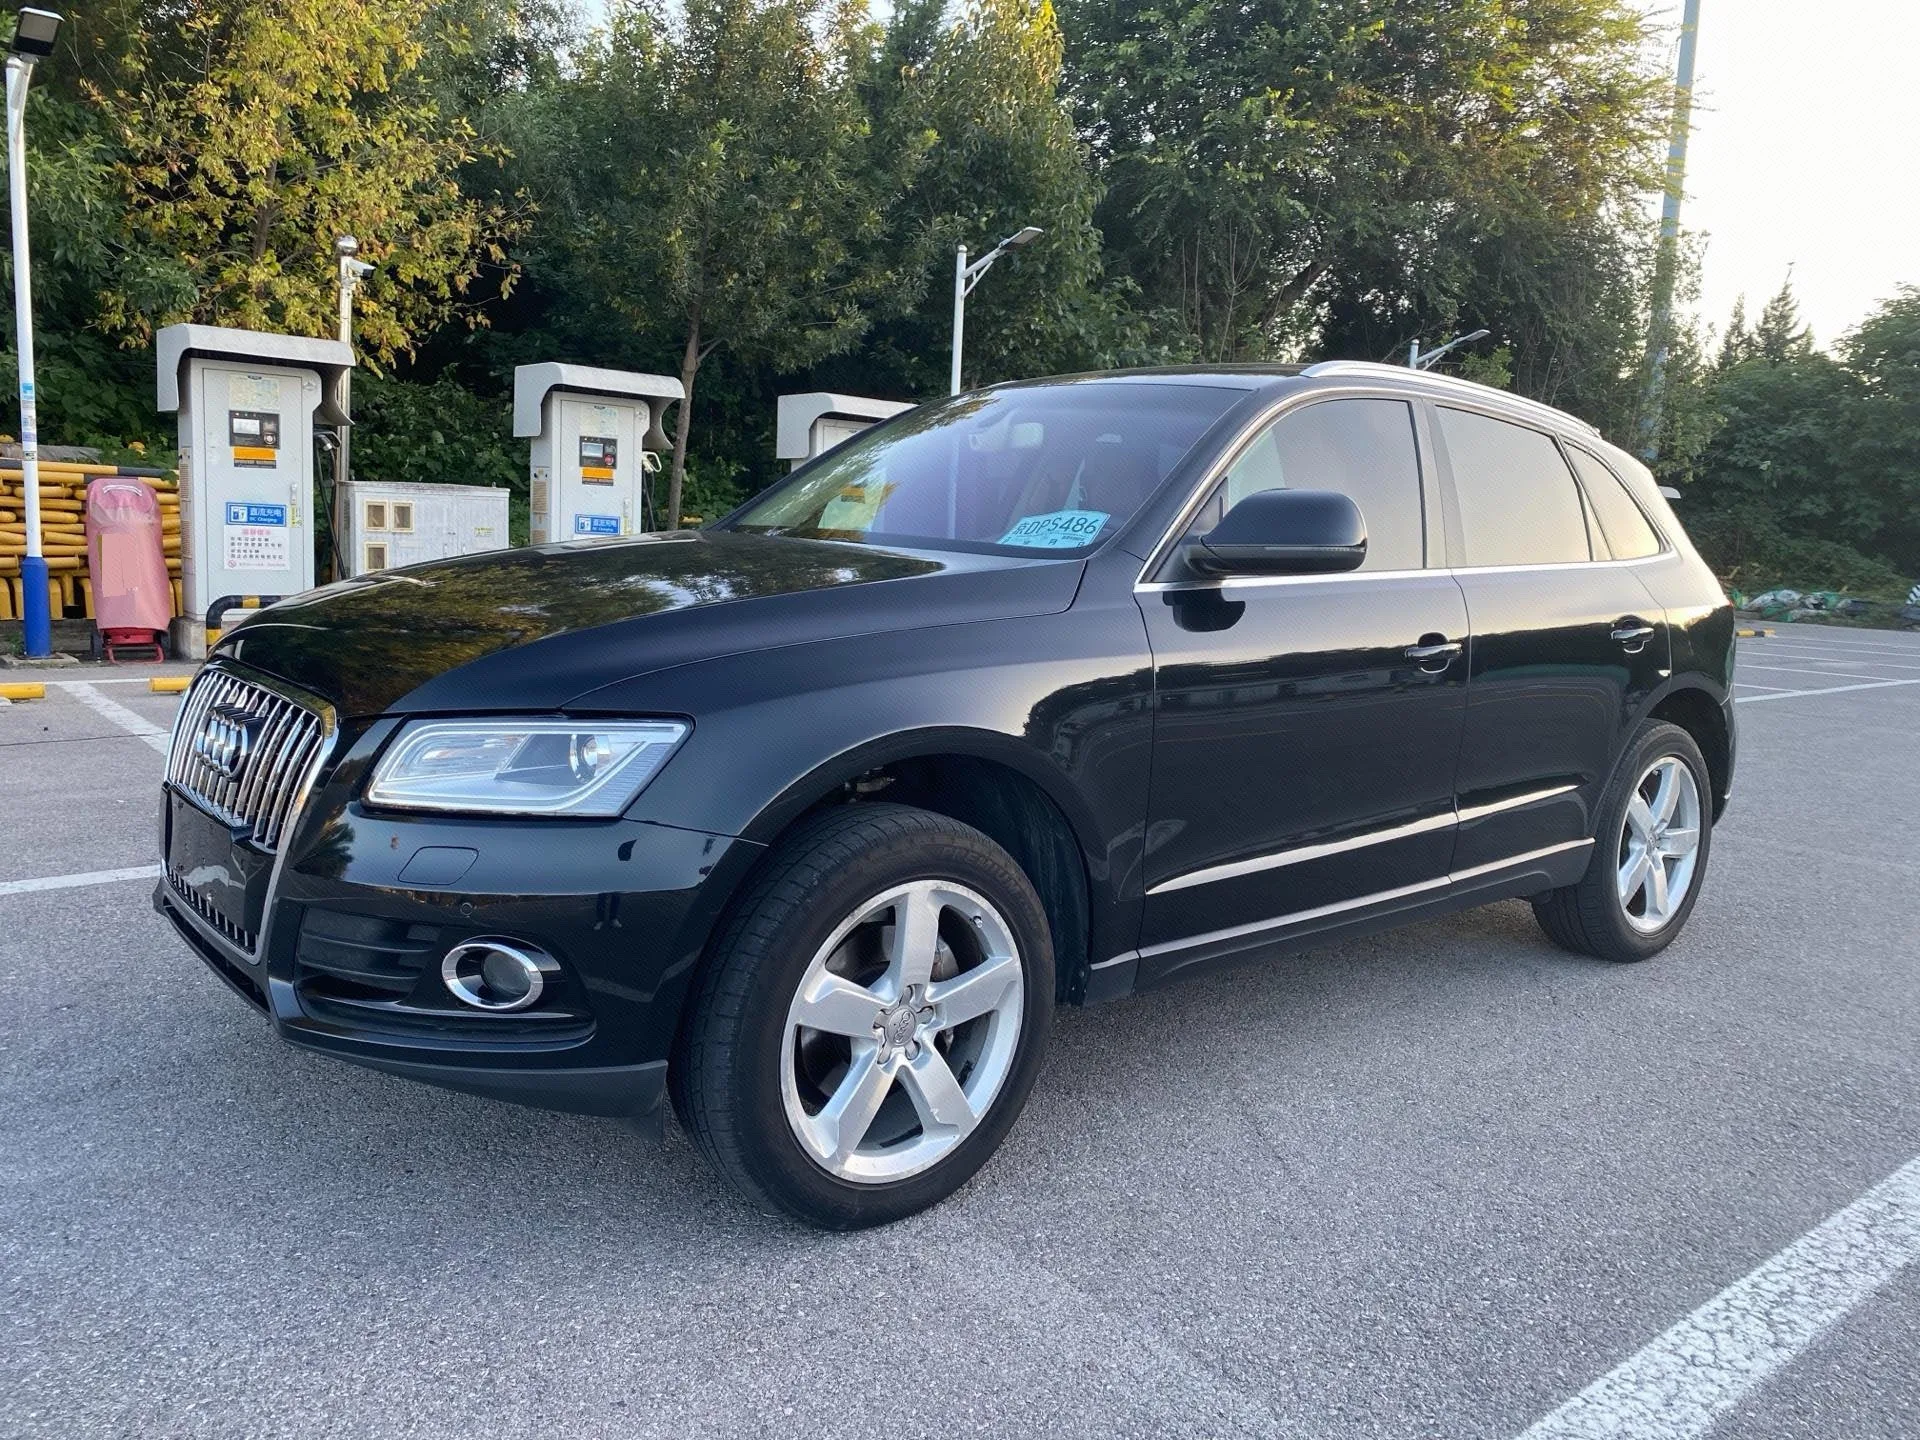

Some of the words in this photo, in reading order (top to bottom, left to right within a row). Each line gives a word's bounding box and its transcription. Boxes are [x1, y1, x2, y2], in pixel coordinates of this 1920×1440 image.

[250, 507, 282, 517] 直流充电
[1012, 516, 1099, 534] 京DPS486
